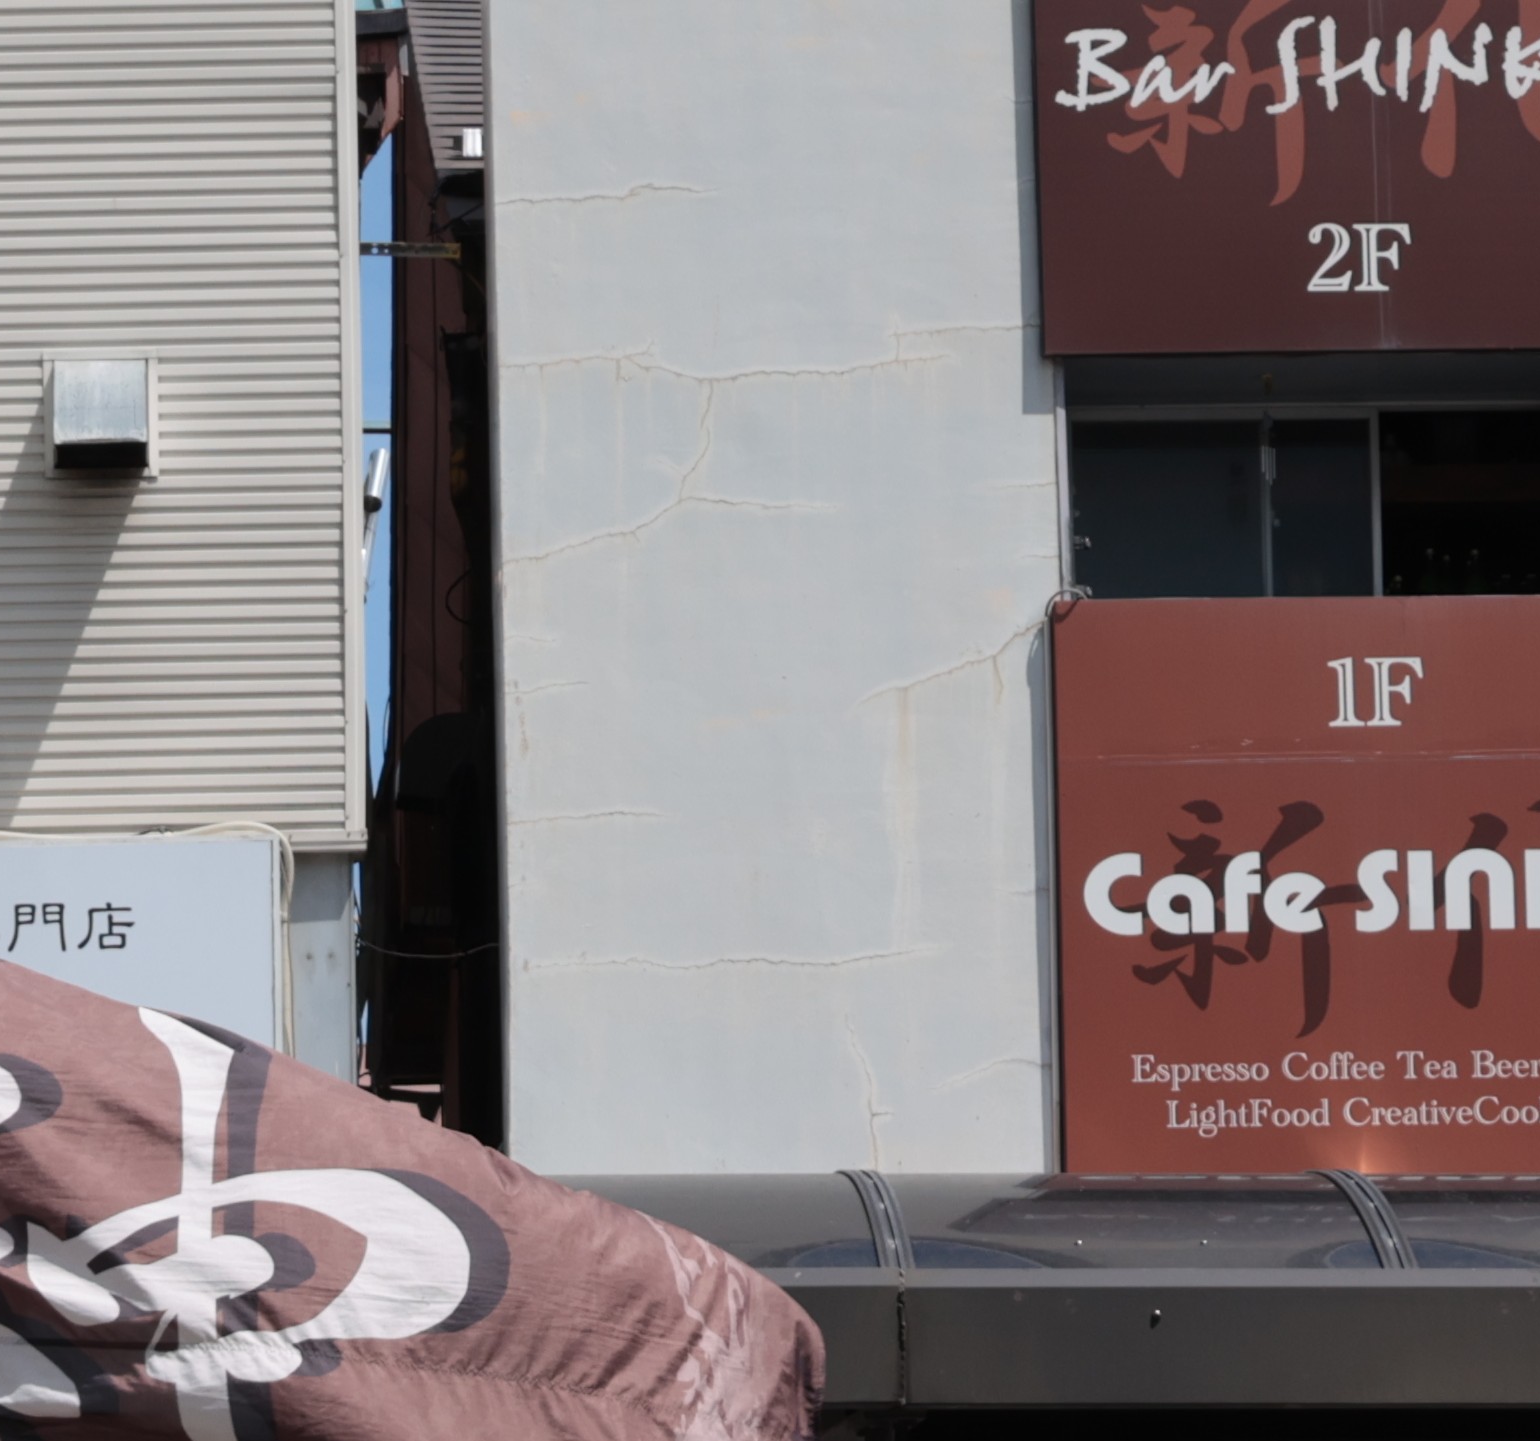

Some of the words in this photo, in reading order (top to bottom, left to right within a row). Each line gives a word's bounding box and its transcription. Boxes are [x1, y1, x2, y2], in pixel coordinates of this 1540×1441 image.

[1056, 28, 1235, 110] Bar
[1306, 222, 1411, 293] 2F
[1327, 656, 1423, 728] 1F
[1083, 850, 1326, 936] Cafe
[1131, 1053, 1269, 1092] Espresso
[1281, 1051, 1385, 1082] Coffee
[1396, 1051, 1458, 1080] Tea
[1166, 1098, 1330, 1138] LightFood
